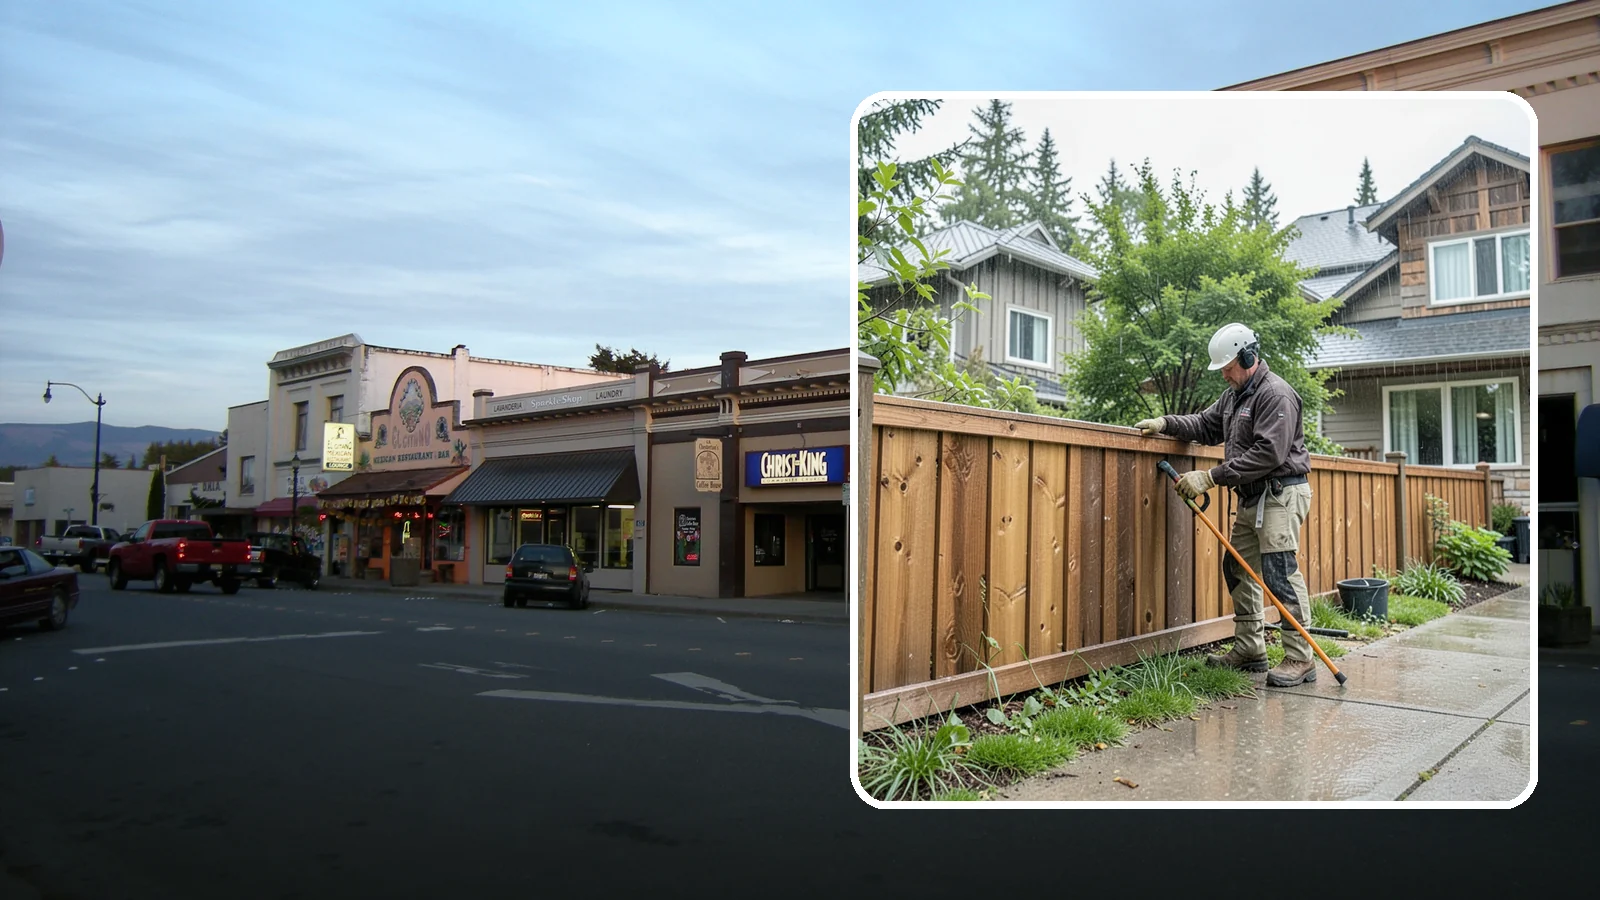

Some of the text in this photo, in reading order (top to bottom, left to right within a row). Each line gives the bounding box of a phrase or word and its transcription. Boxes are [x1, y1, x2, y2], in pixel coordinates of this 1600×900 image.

[595, 388, 624, 400] LAUNDRY
[493, 401, 523, 413] LAVANDERIA
[373, 454, 396, 465] MEXICAN
[398, 451, 433, 463] RESTAURANT
[438, 449, 450, 459] BAR
